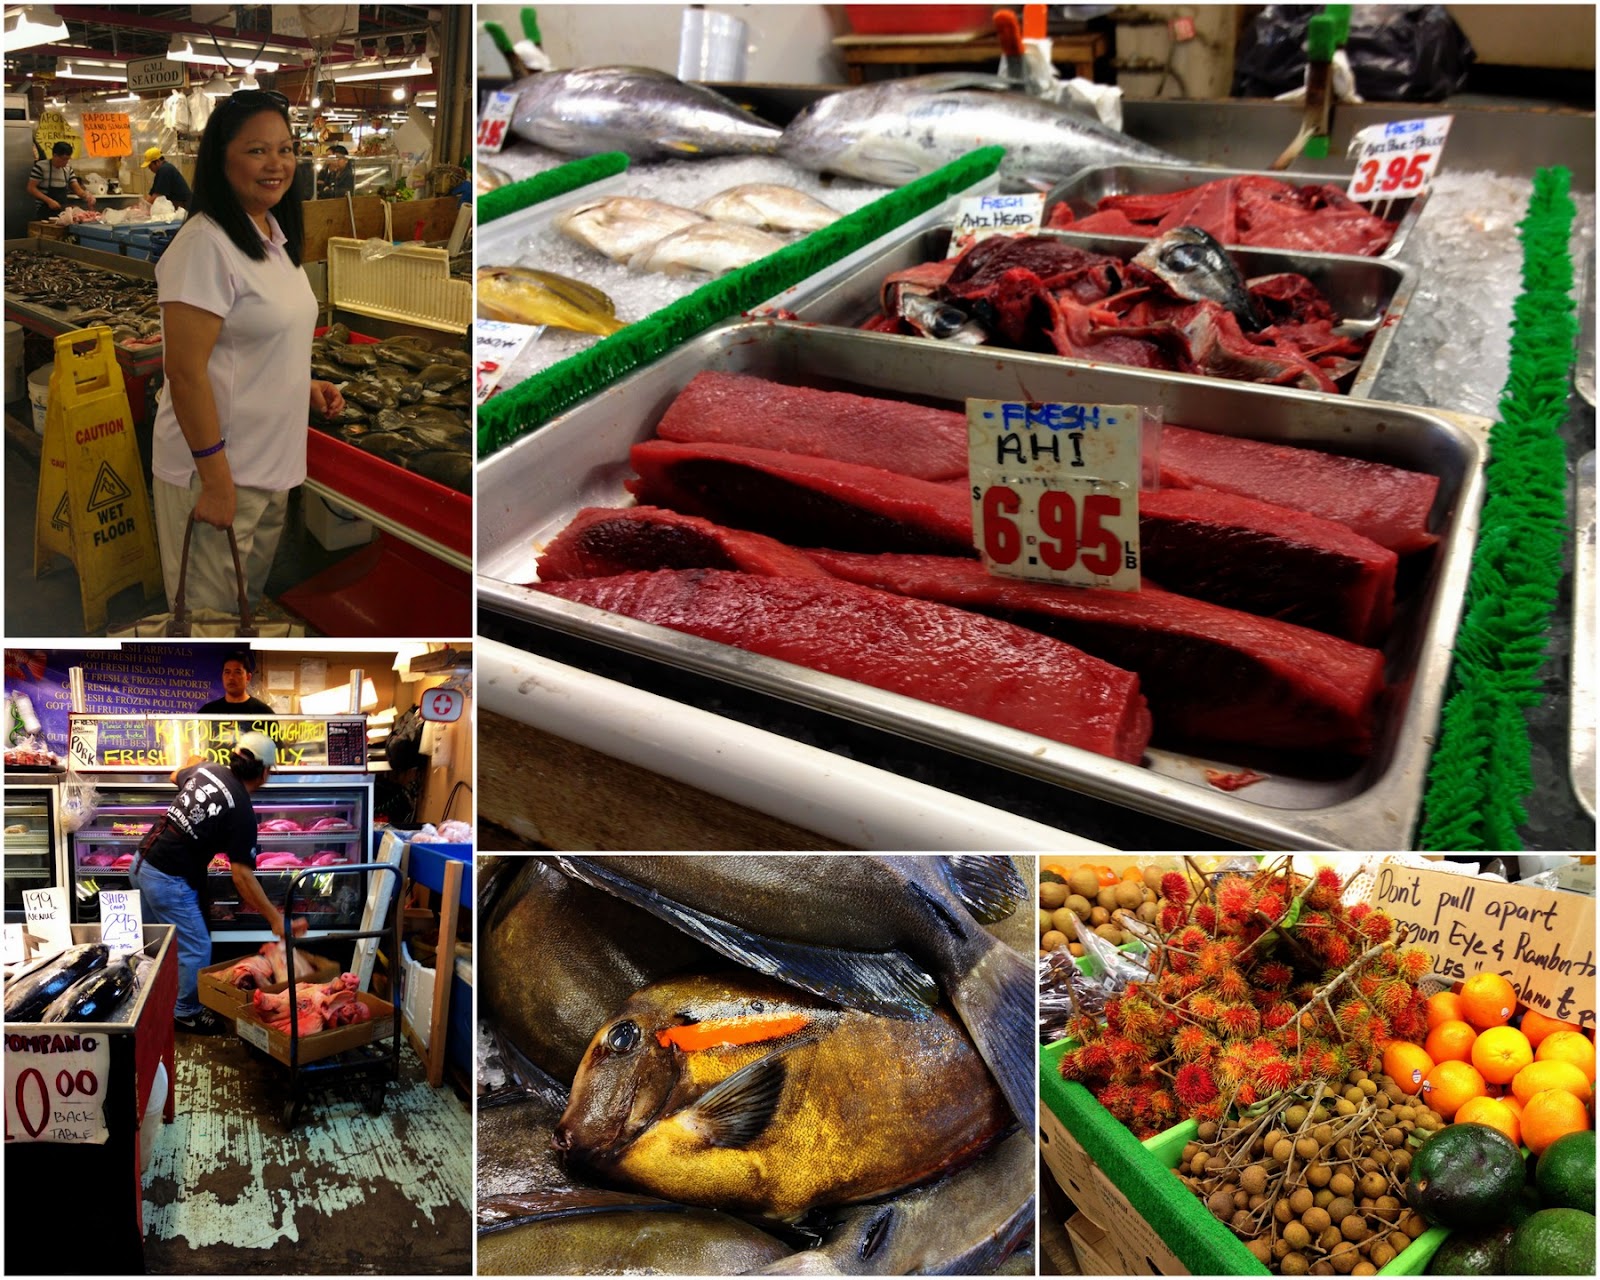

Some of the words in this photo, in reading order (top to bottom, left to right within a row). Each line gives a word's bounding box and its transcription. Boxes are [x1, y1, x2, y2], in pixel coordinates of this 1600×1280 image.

[132, 71, 179, 86] SEAFOOD
[91, 131, 129, 153] PORK
[993, 211, 1033, 228] HEAD
[1001, 403, 1100, 431] FRESH
[75, 418, 124, 445] CAUTION
[997, 433, 1085, 467] AHI
[97, 503, 124, 525] WET
[93, 518, 136, 547] FLOOR
[86, 651, 106, 660] GOT
[107, 652, 136, 662] FRESH
[121, 644, 140, 653] ESH
[143, 645, 193, 657] ARRIVALS
[80, 661, 98, 670] GOT
[101, 662, 129, 673] FRESH
[131, 665, 166, 676] ISLAND
[167, 667, 194, 677] PORK!
[92, 672, 120, 683] FRESH
[122, 675, 129, 684] &
[131, 676, 167, 686] FROZEN
[169, 678, 212, 689] IMPORTS!
[112, 685, 120, 693] &
[122, 686, 158, 696] FROZEN
[160, 688, 209, 700] SEAFOODS!
[66, 702, 95, 713] FSH
[97, 705, 129, 714] FRUITS
[107, 695, 113, 703] &
[115, 696, 150, 706] FROZEN
[152, 699, 198, 710] POULTRY!
[71, 735, 95, 766] PORK
[104, 748, 170, 766] FRESH
[101, 892, 129, 906] SHIBI
[1378, 868, 1422, 907] Don't
[1433, 886, 1475, 926] pull
[1484, 900, 1559, 931] apart
[1448, 920, 1488, 957] Eye
[54, 1111, 95, 1123] BACK
[50, 1128, 94, 1140] TABLE
